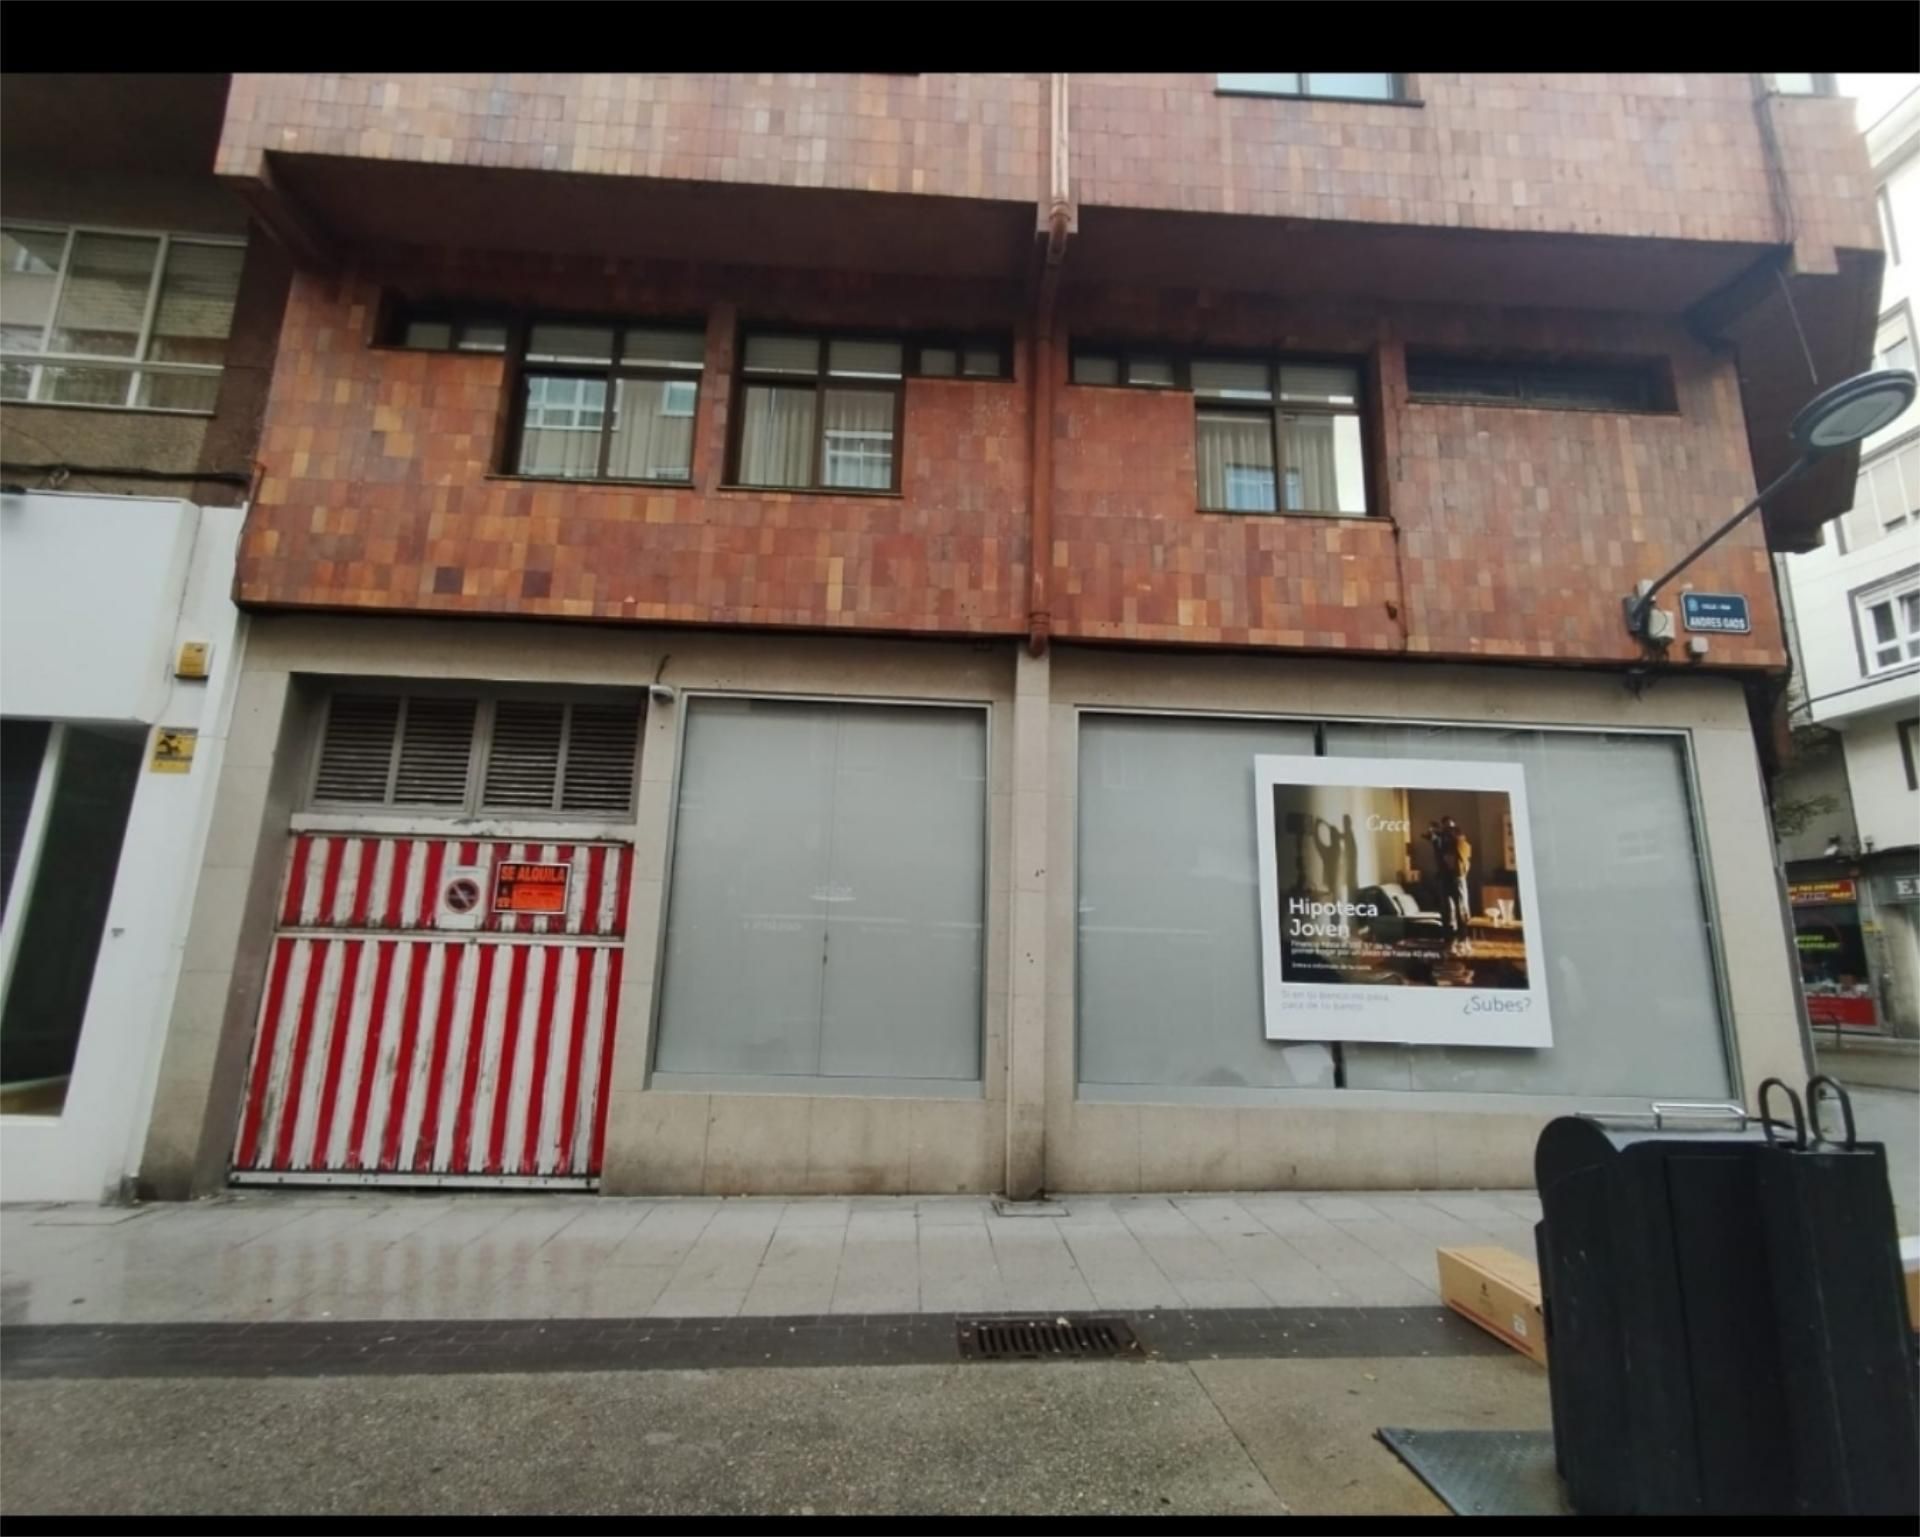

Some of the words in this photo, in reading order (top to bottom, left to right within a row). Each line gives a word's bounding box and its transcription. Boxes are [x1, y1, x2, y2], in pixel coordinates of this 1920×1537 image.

[501, 865, 515, 881] SE
[517, 866, 565, 883] ALQUILA
[1288, 897, 1379, 919] Hipoteca
[1289, 918, 1350, 939] Joven
[1463, 994, 1532, 1015] ¿Subes?
